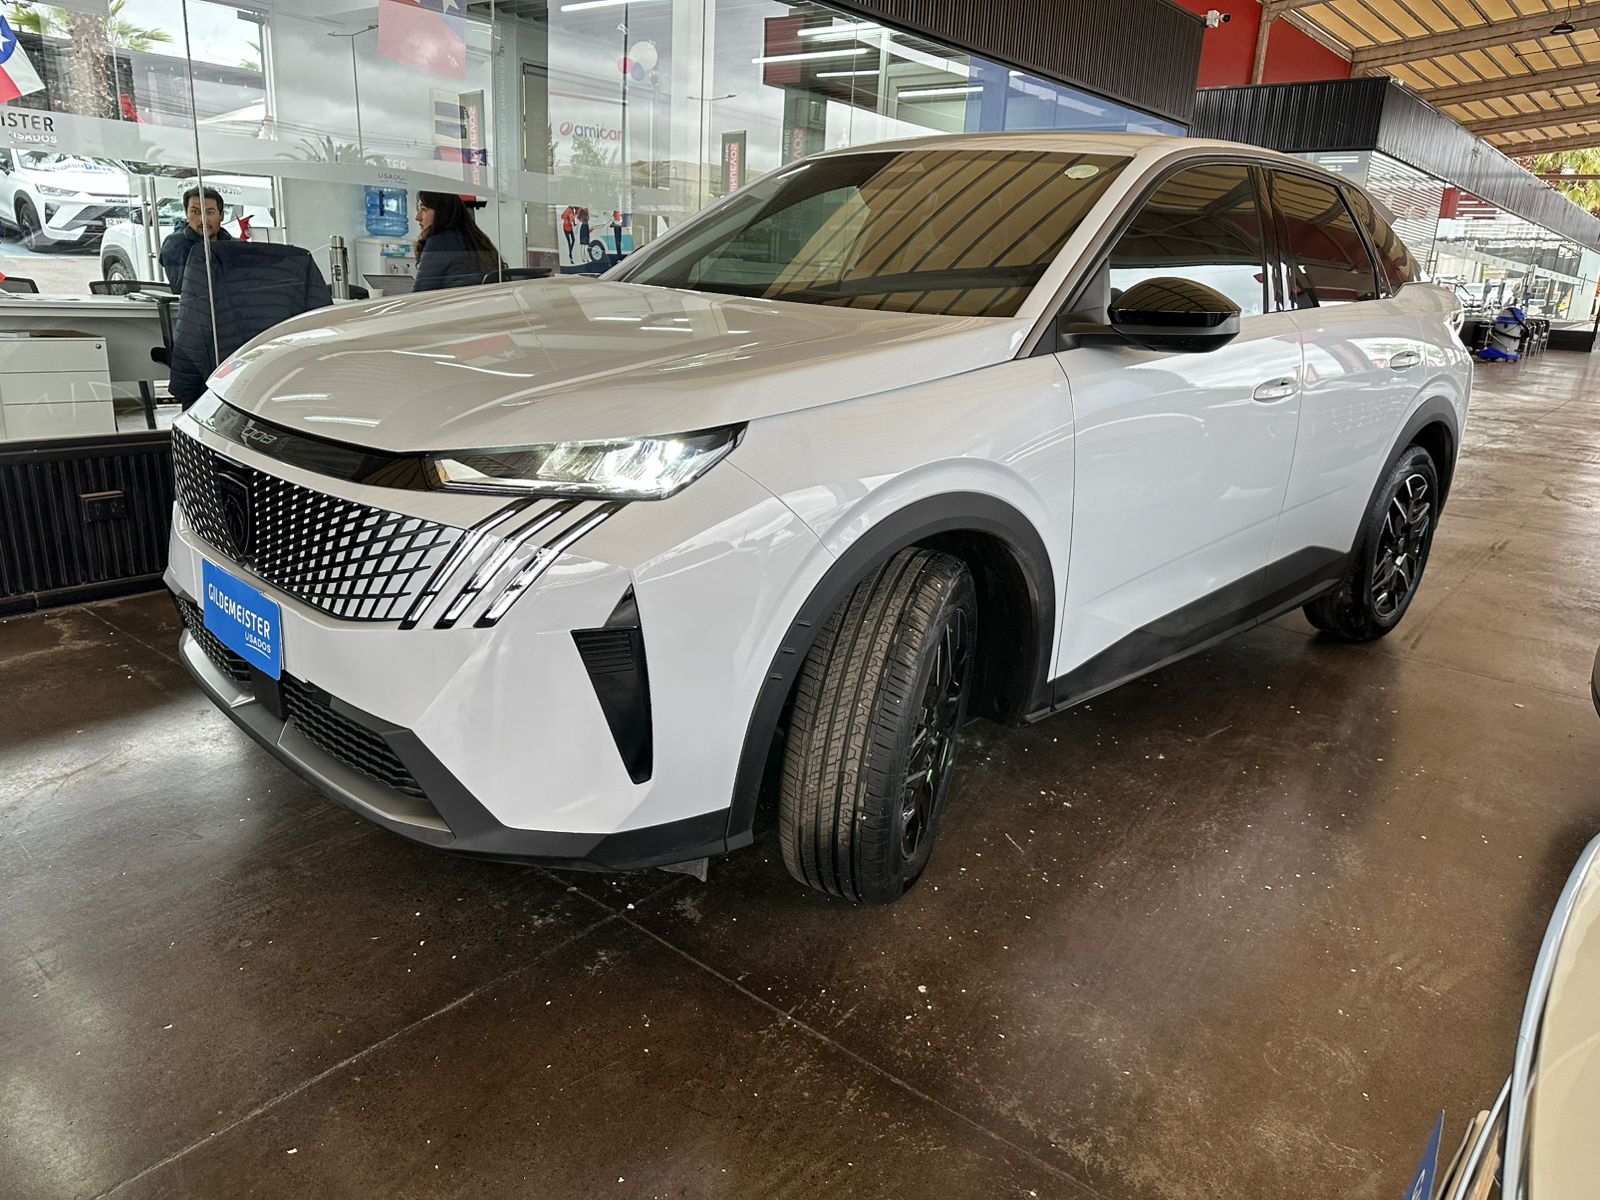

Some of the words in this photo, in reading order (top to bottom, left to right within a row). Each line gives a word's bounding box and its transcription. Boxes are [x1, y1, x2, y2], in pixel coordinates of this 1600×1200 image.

[574, 123, 622, 141] amicar
[208, 583, 271, 640] GILDEMEISTER
[244, 630, 272, 653] USADOS
